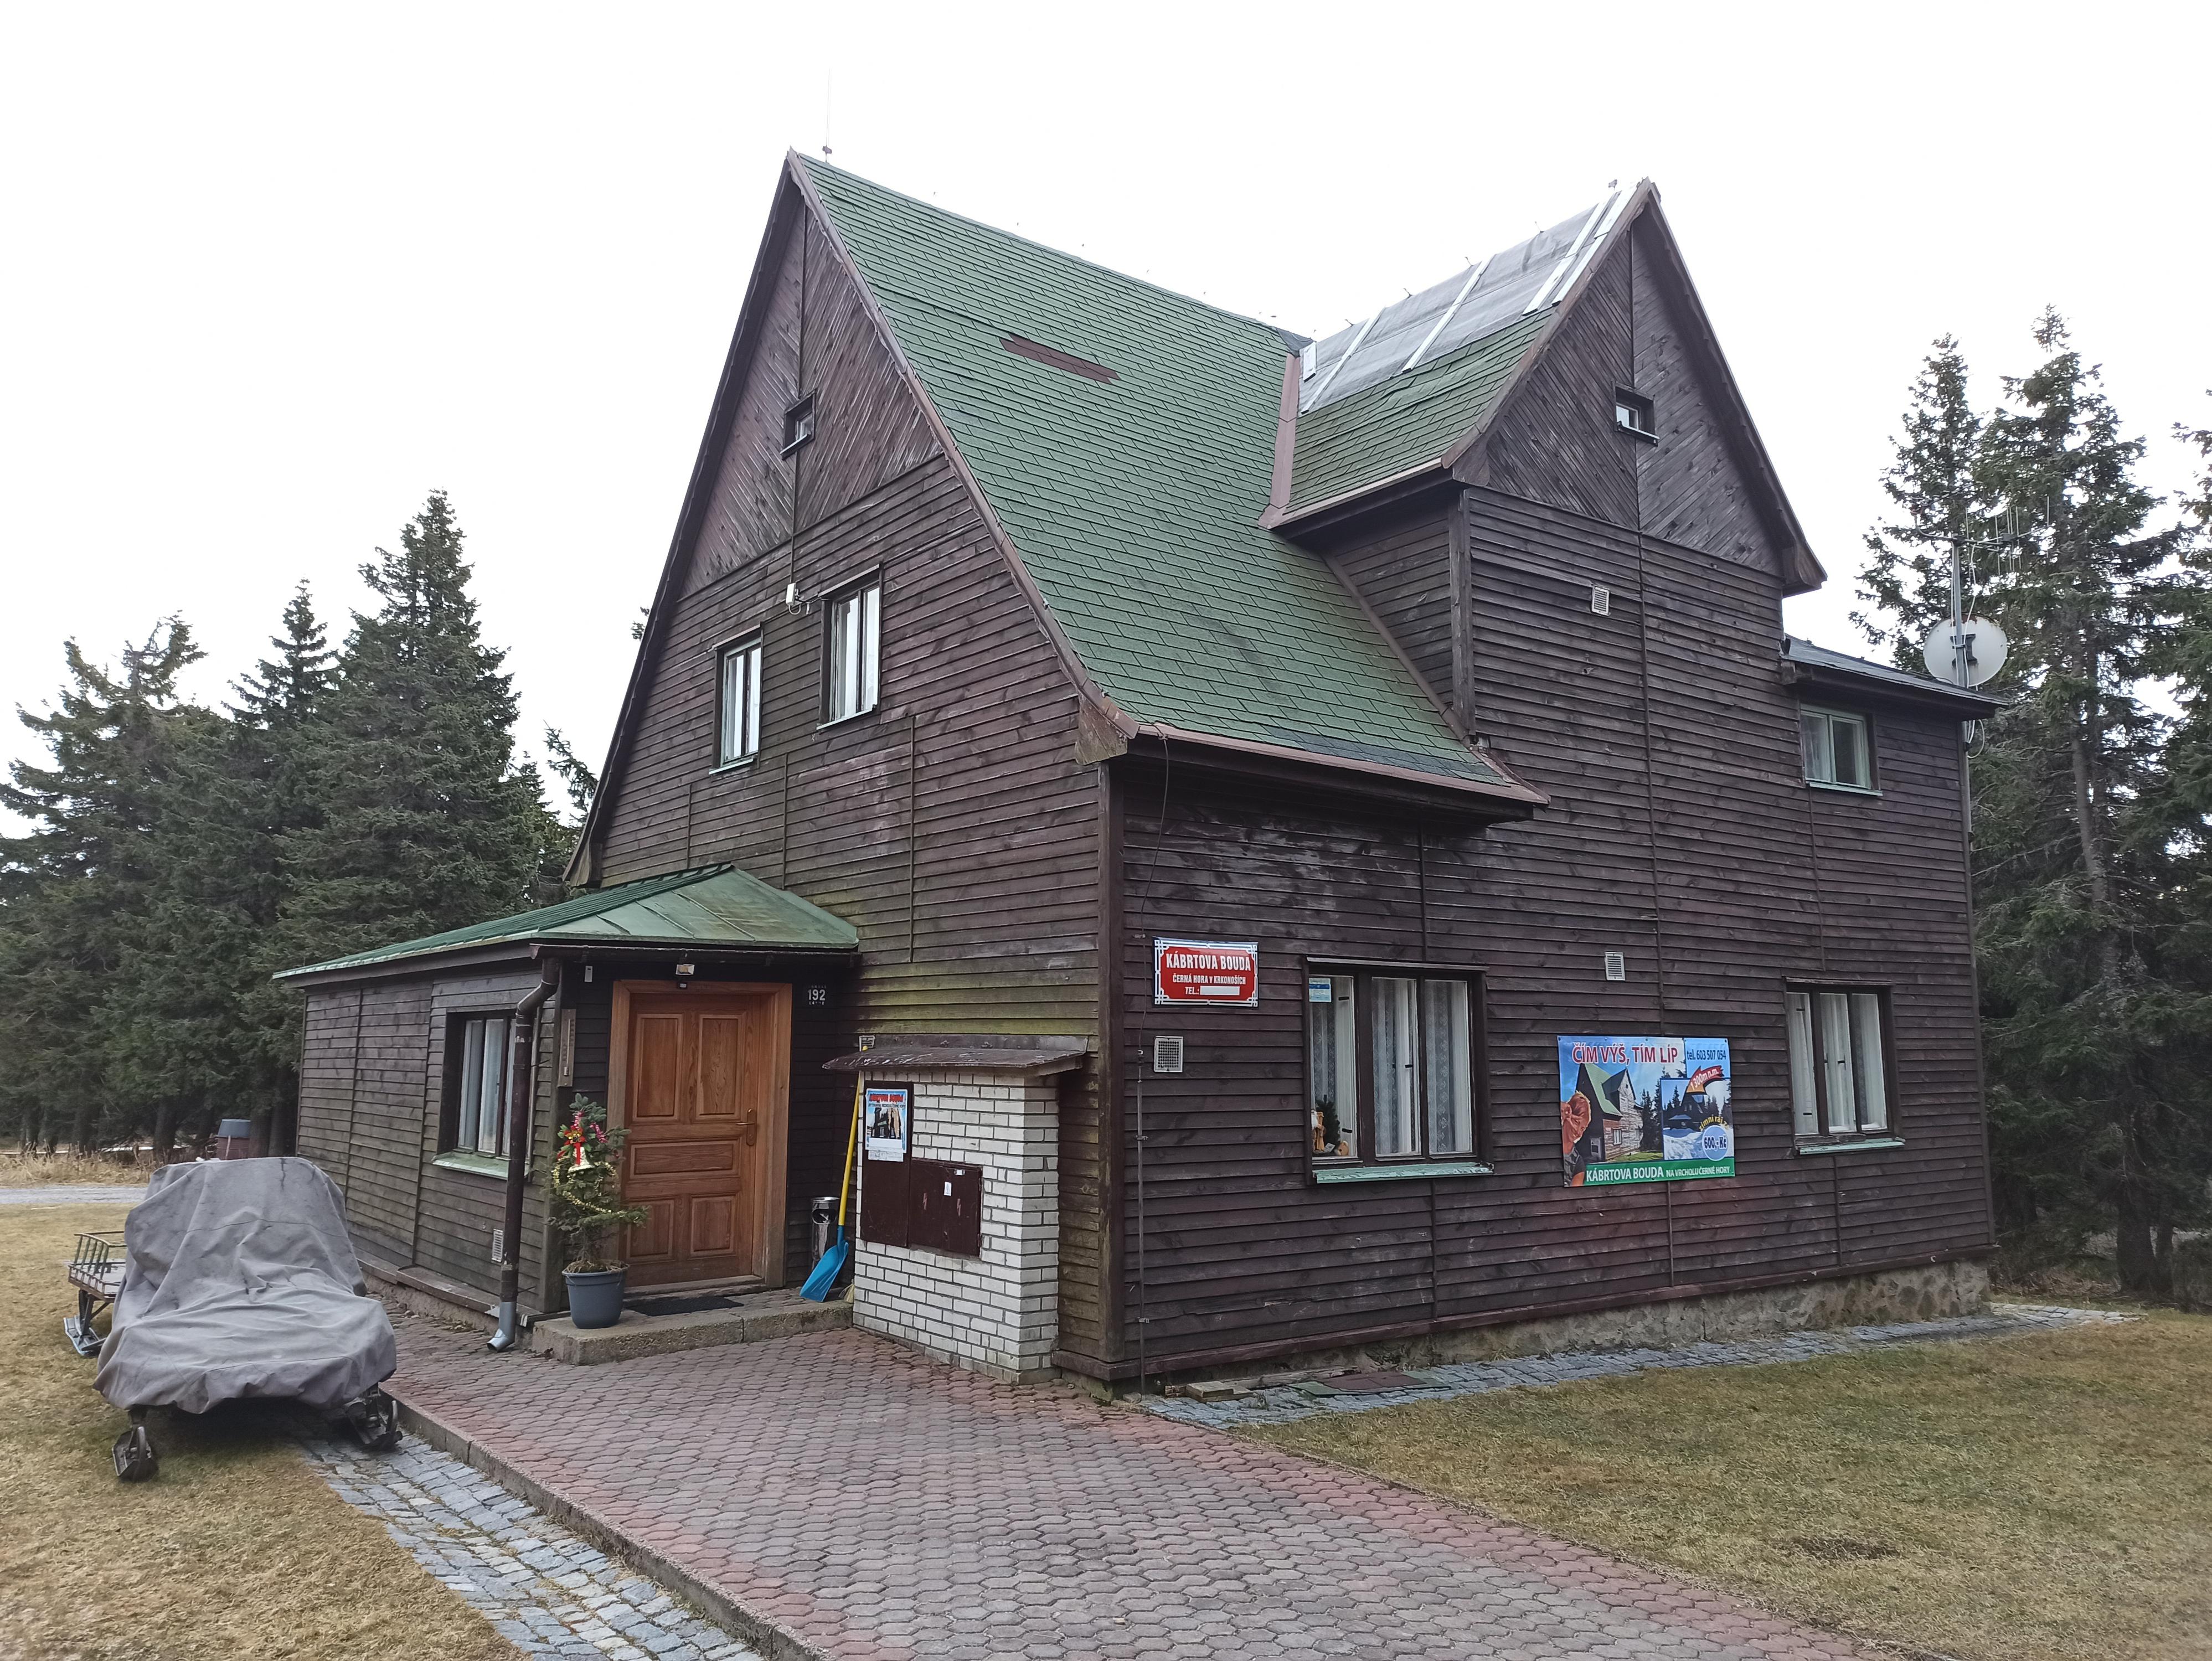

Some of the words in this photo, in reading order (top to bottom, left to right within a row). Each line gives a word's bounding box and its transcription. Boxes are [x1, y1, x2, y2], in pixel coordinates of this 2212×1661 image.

[1166, 951, 1218, 969] KÁBRTOVA
[1220, 955, 1251, 971] BOUDA
[1172, 973, 1192, 983] ČERNÁ
[1193, 975, 1208, 983] HORA
[1214, 974, 1246, 984] KRKONOŠÍCH
[808, 989, 826, 1000] 192
[1572, 1042, 1598, 1063] ČÍM
[1600, 1043, 1630, 1065] VÝŠ,
[1632, 1043, 1656, 1063] TÍM
[1660, 1044, 1678, 1063] LÍP
[1687, 1049, 1695, 1060] tel.
[1697, 1050, 1706, 1060] 603
[1706, 1050, 1715, 1060] 507
[1717, 1050, 1726, 1060] 054
[1586, 1167, 1632, 1182] KÁBRTOVA
[1633, 1166, 1664, 1179] BOUDA
[1674, 1168, 1699, 1177] VRCHOLU
[1699, 1165, 1715, 1175] ČERNÉ
